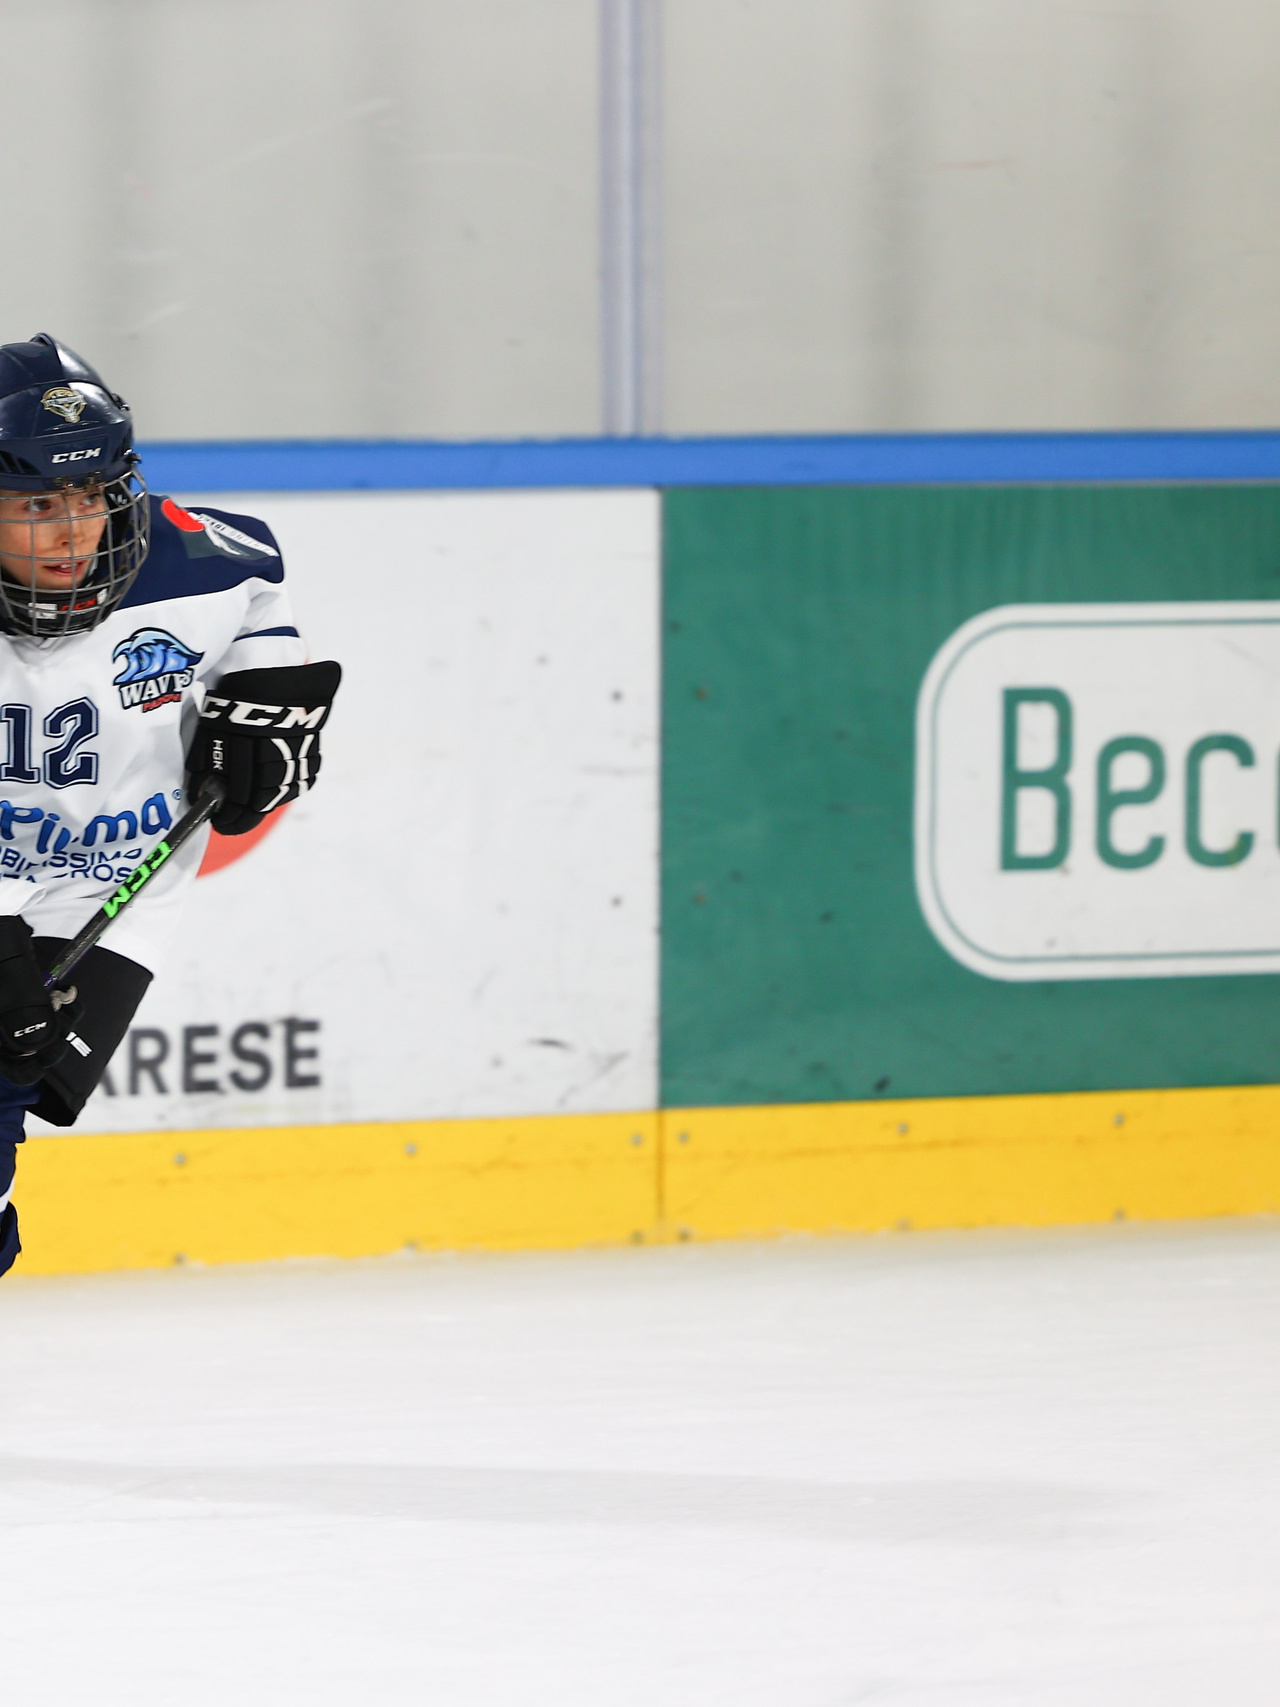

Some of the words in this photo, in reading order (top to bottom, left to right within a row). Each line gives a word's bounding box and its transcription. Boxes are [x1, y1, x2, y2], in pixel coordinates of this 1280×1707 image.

[51, 447, 102, 464] CCM
[0, 697, 99, 789] 12
[201, 695, 327, 729] CCM
[1000, 687, 1280, 872] Bec
[103, 841, 171, 919] CCM
[14, 1021, 48, 1038] CCM
[99, 1016, 322, 1097] RESE
